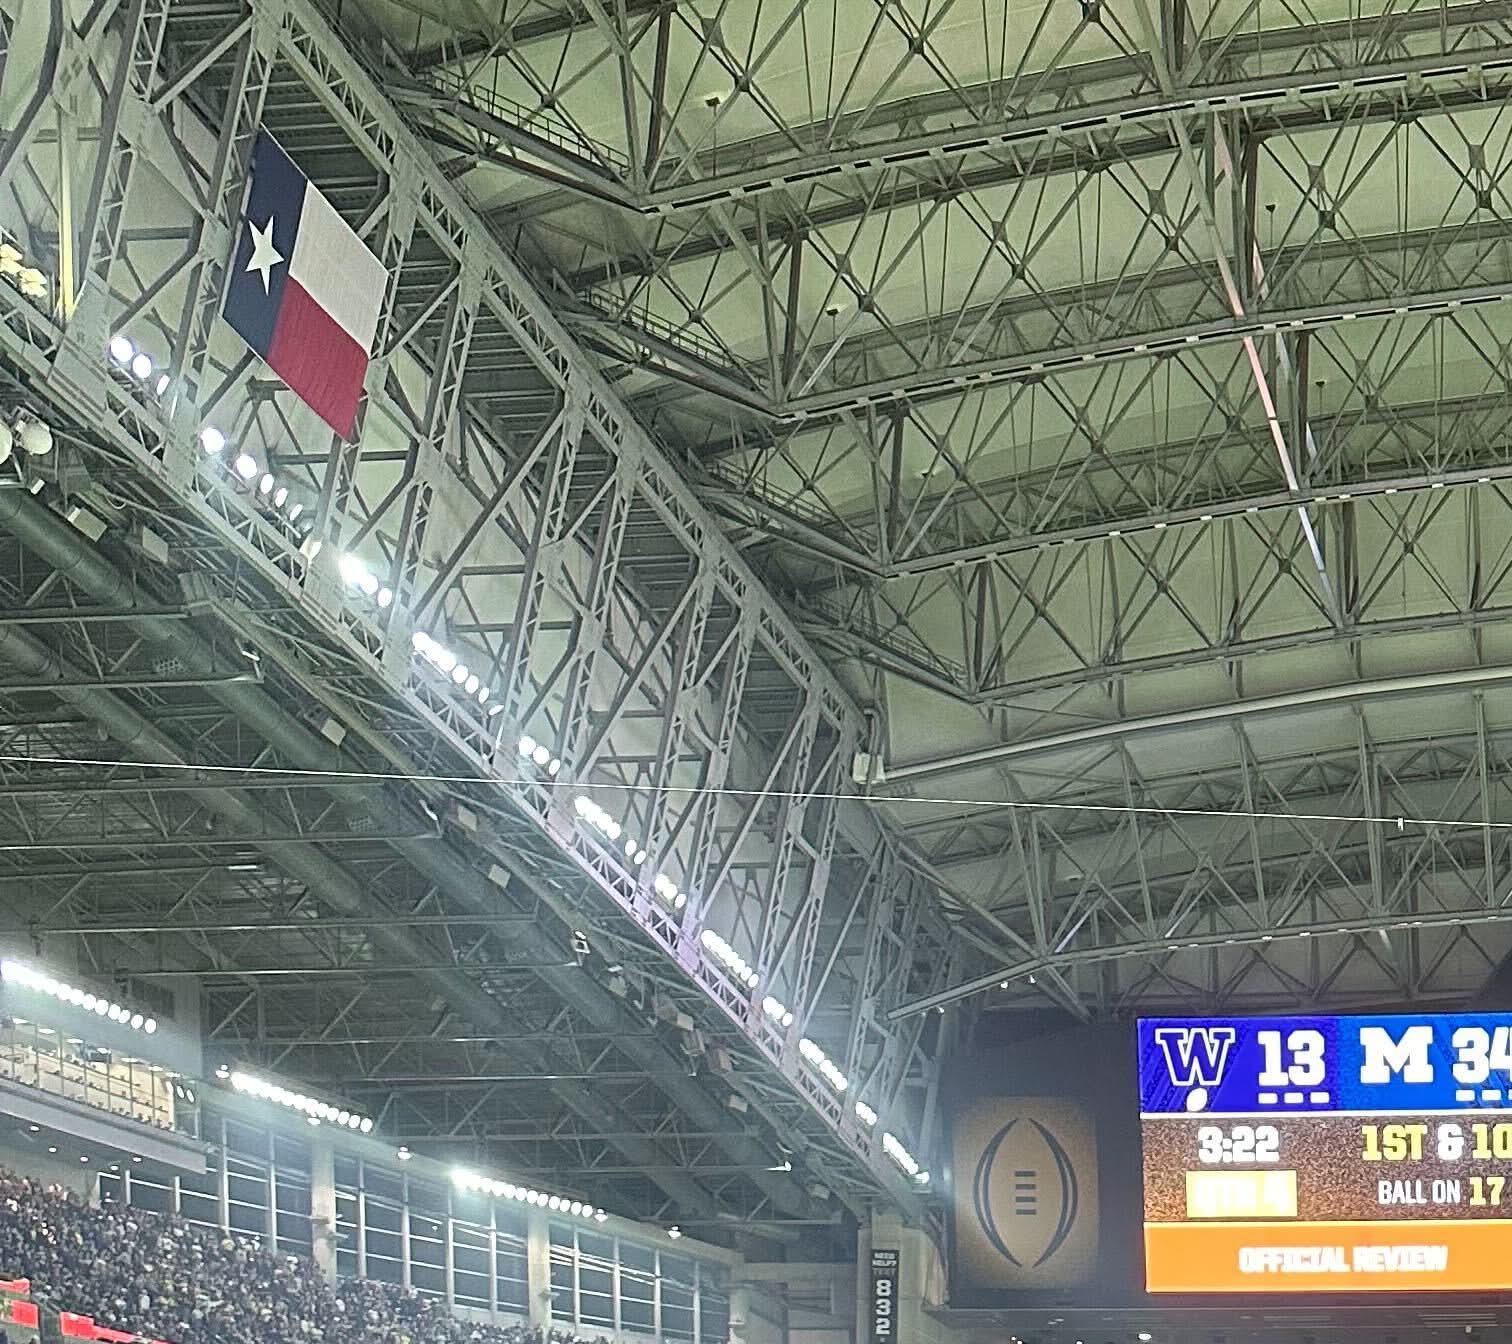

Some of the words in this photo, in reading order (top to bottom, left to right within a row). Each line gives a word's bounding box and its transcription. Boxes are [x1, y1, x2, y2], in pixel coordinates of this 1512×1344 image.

[1155, 1028, 1236, 1086] W
[1257, 1029, 1326, 1086] 13
[1360, 1025, 1434, 1083] M
[1198, 1125, 1280, 1163] 3:22
[1362, 1124, 1428, 1161] 1ST
[1437, 1123, 1465, 1160] &
[1378, 1179, 1427, 1205] BALL
[1432, 1179, 1461, 1204] ON
[1469, 1177, 1505, 1205] 17
[1238, 1246, 1351, 1273] OFFICIAL
[1352, 1244, 1449, 1272] REVIEW
